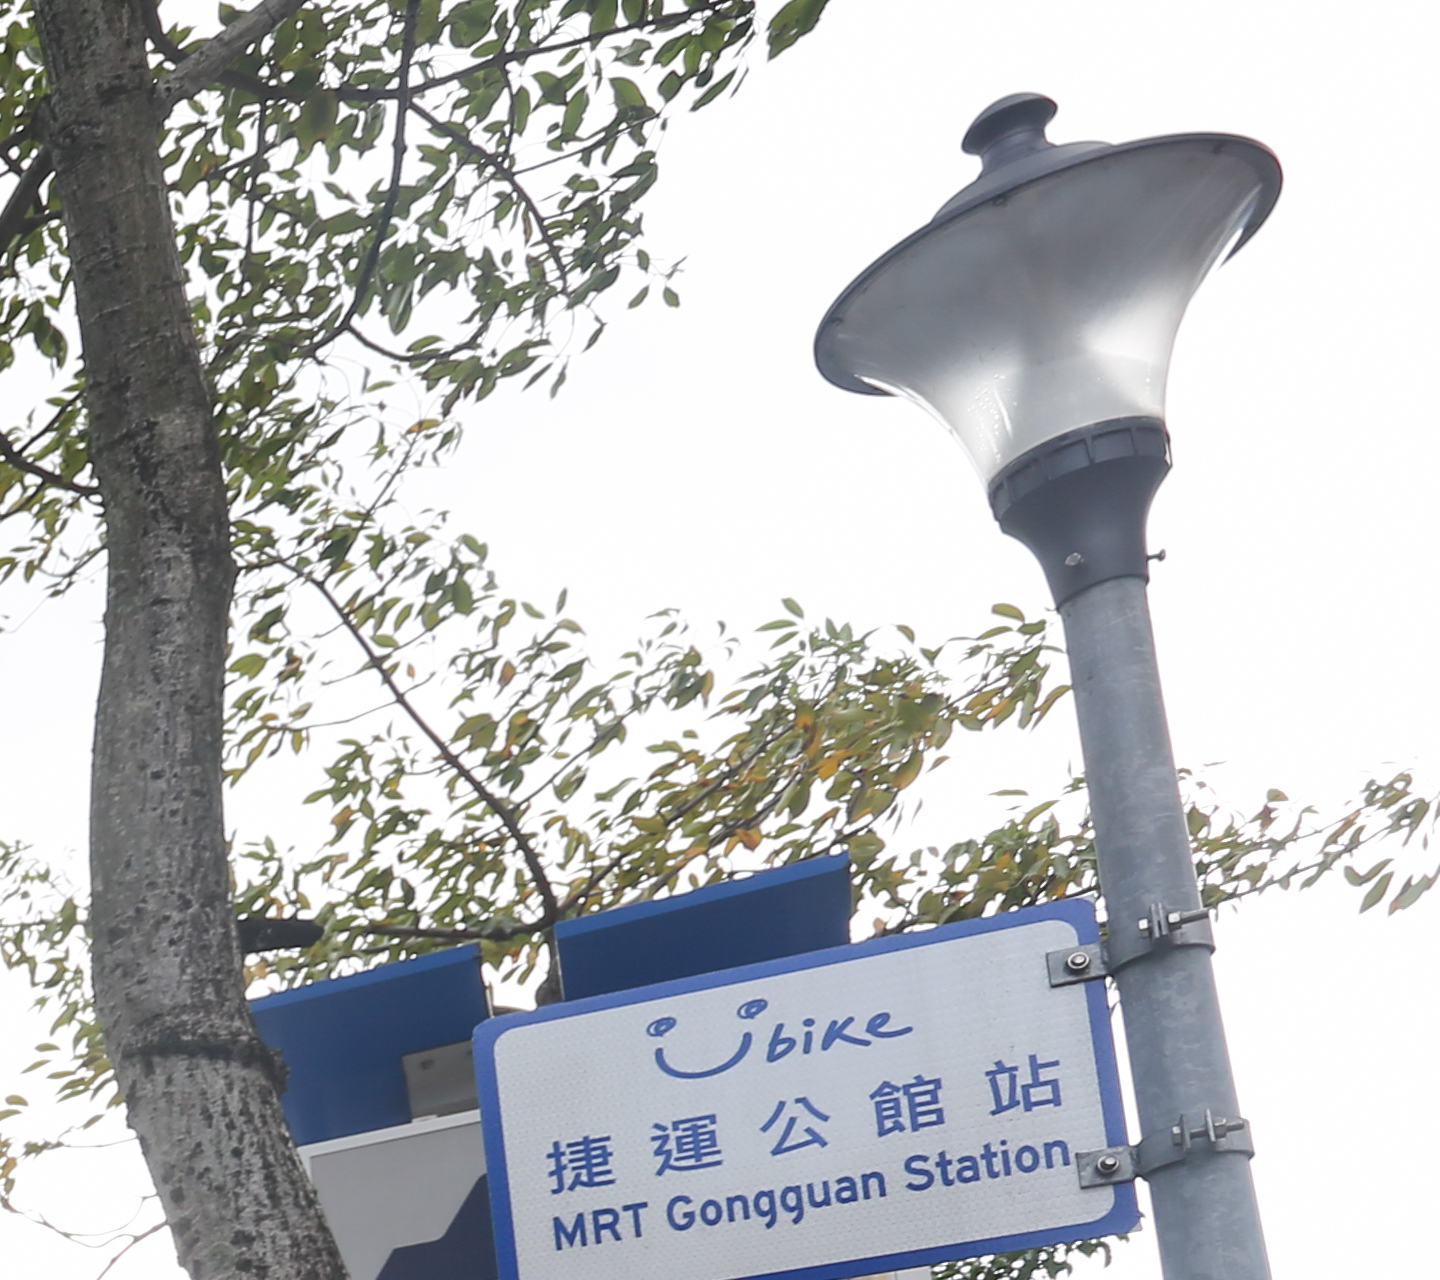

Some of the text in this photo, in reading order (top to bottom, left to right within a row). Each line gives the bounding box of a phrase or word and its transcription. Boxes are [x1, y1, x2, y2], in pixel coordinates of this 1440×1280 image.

[546, 1053, 1064, 1196] 捷運公館站
[552, 1136, 1072, 1251] MRT Gongguan Station
